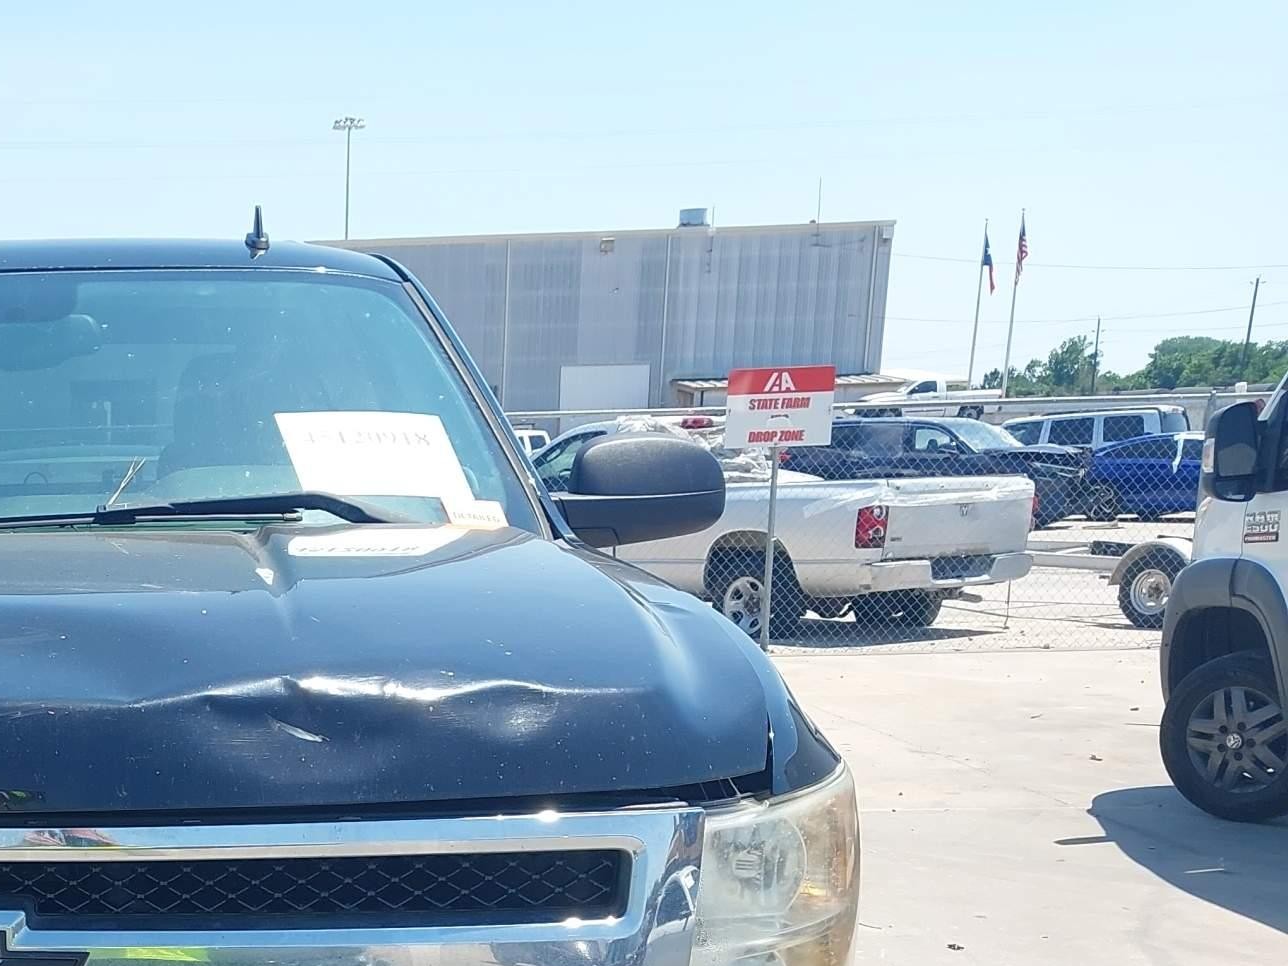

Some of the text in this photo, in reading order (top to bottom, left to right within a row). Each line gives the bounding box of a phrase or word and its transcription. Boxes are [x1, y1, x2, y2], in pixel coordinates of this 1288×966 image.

[749, 397, 810, 410] STATE FARM
[748, 430, 805, 443] DROP ZONE
